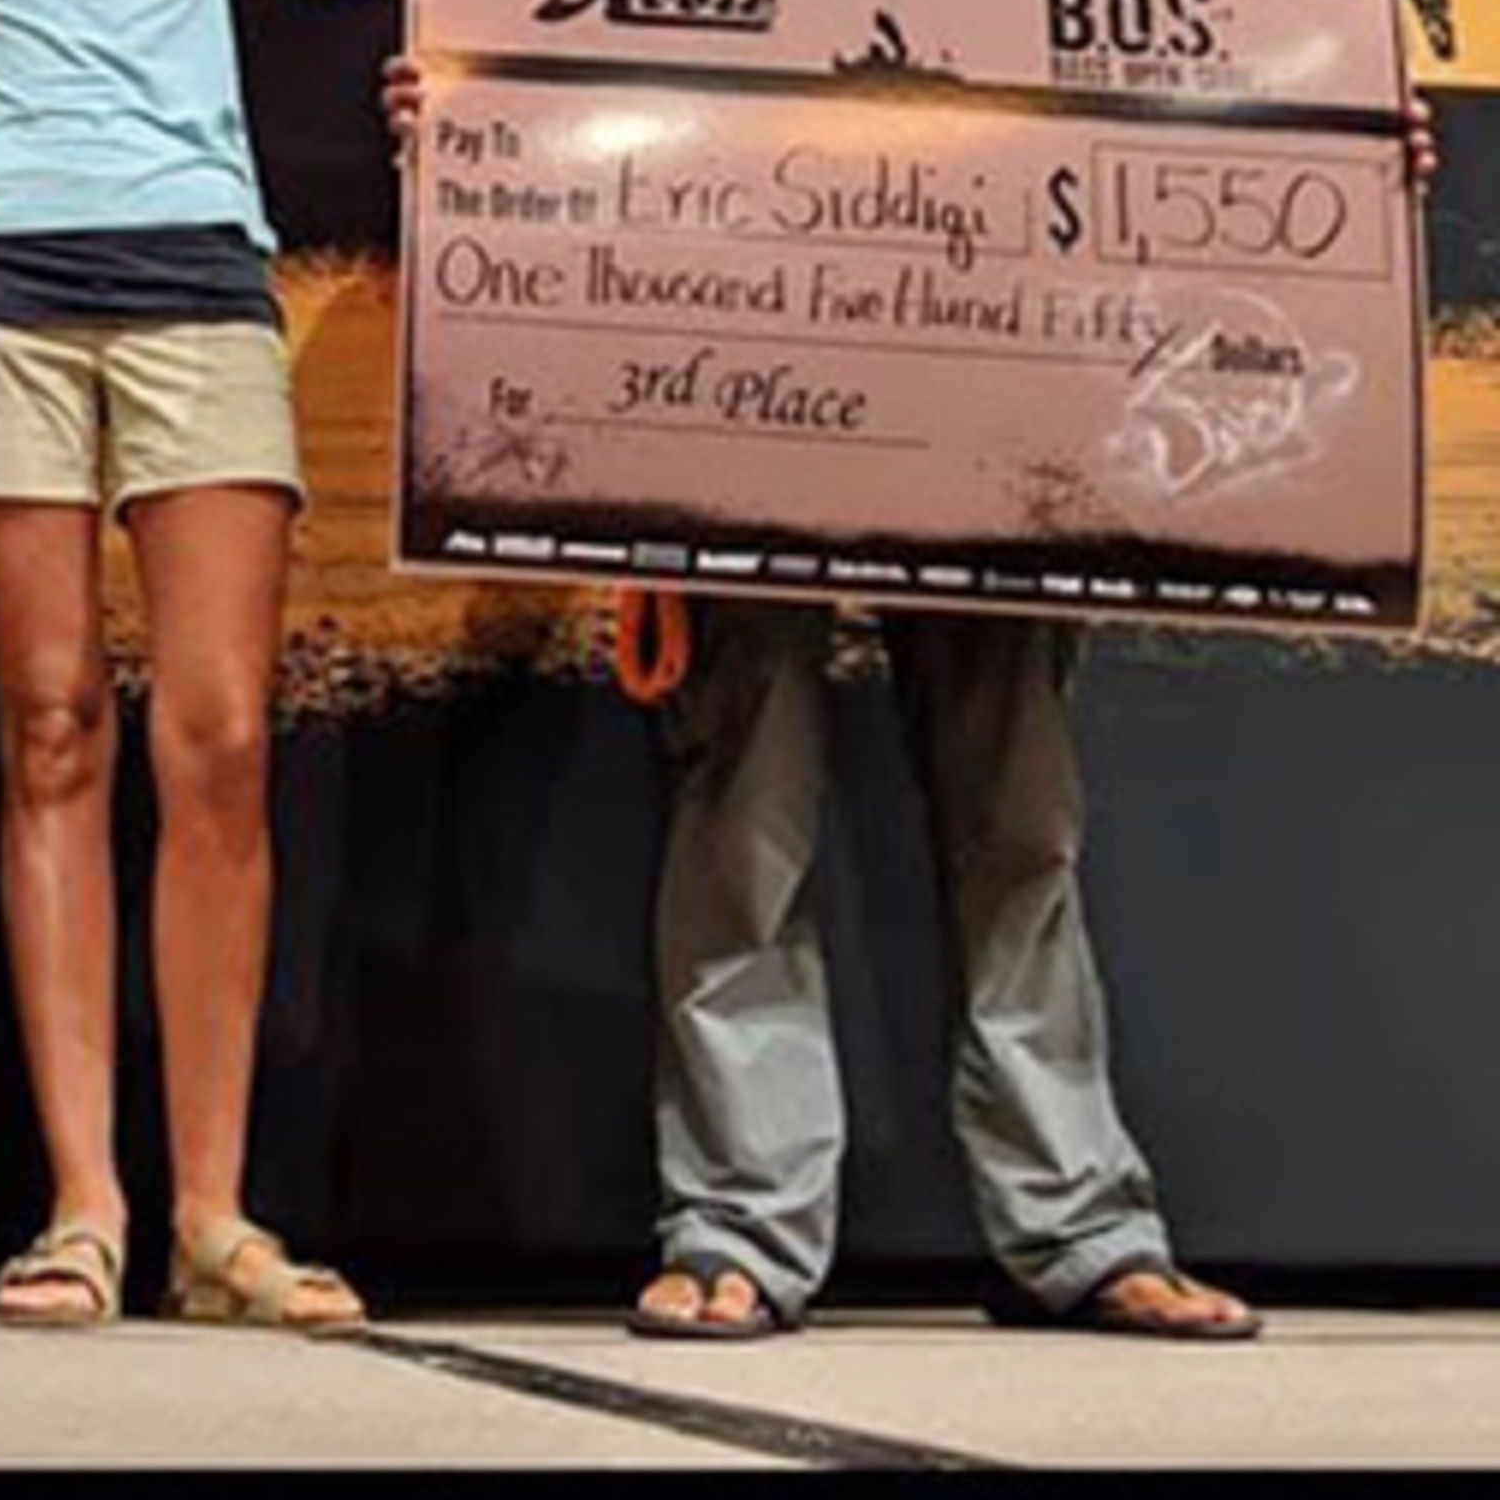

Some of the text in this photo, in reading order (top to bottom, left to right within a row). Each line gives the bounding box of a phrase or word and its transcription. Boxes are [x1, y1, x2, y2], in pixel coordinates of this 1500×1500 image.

[437, 119, 521, 164] Pay To
[437, 180, 486, 219] The
[618, 152, 756, 230] Eric
[1046, 166, 1083, 252] $
[1112, 158, 1350, 264] 1,550
[434, 235, 566, 308] One
[586, 244, 789, 315] Thousand
[605, 348, 716, 414] 3rd
[712, 365, 868, 432] Place
